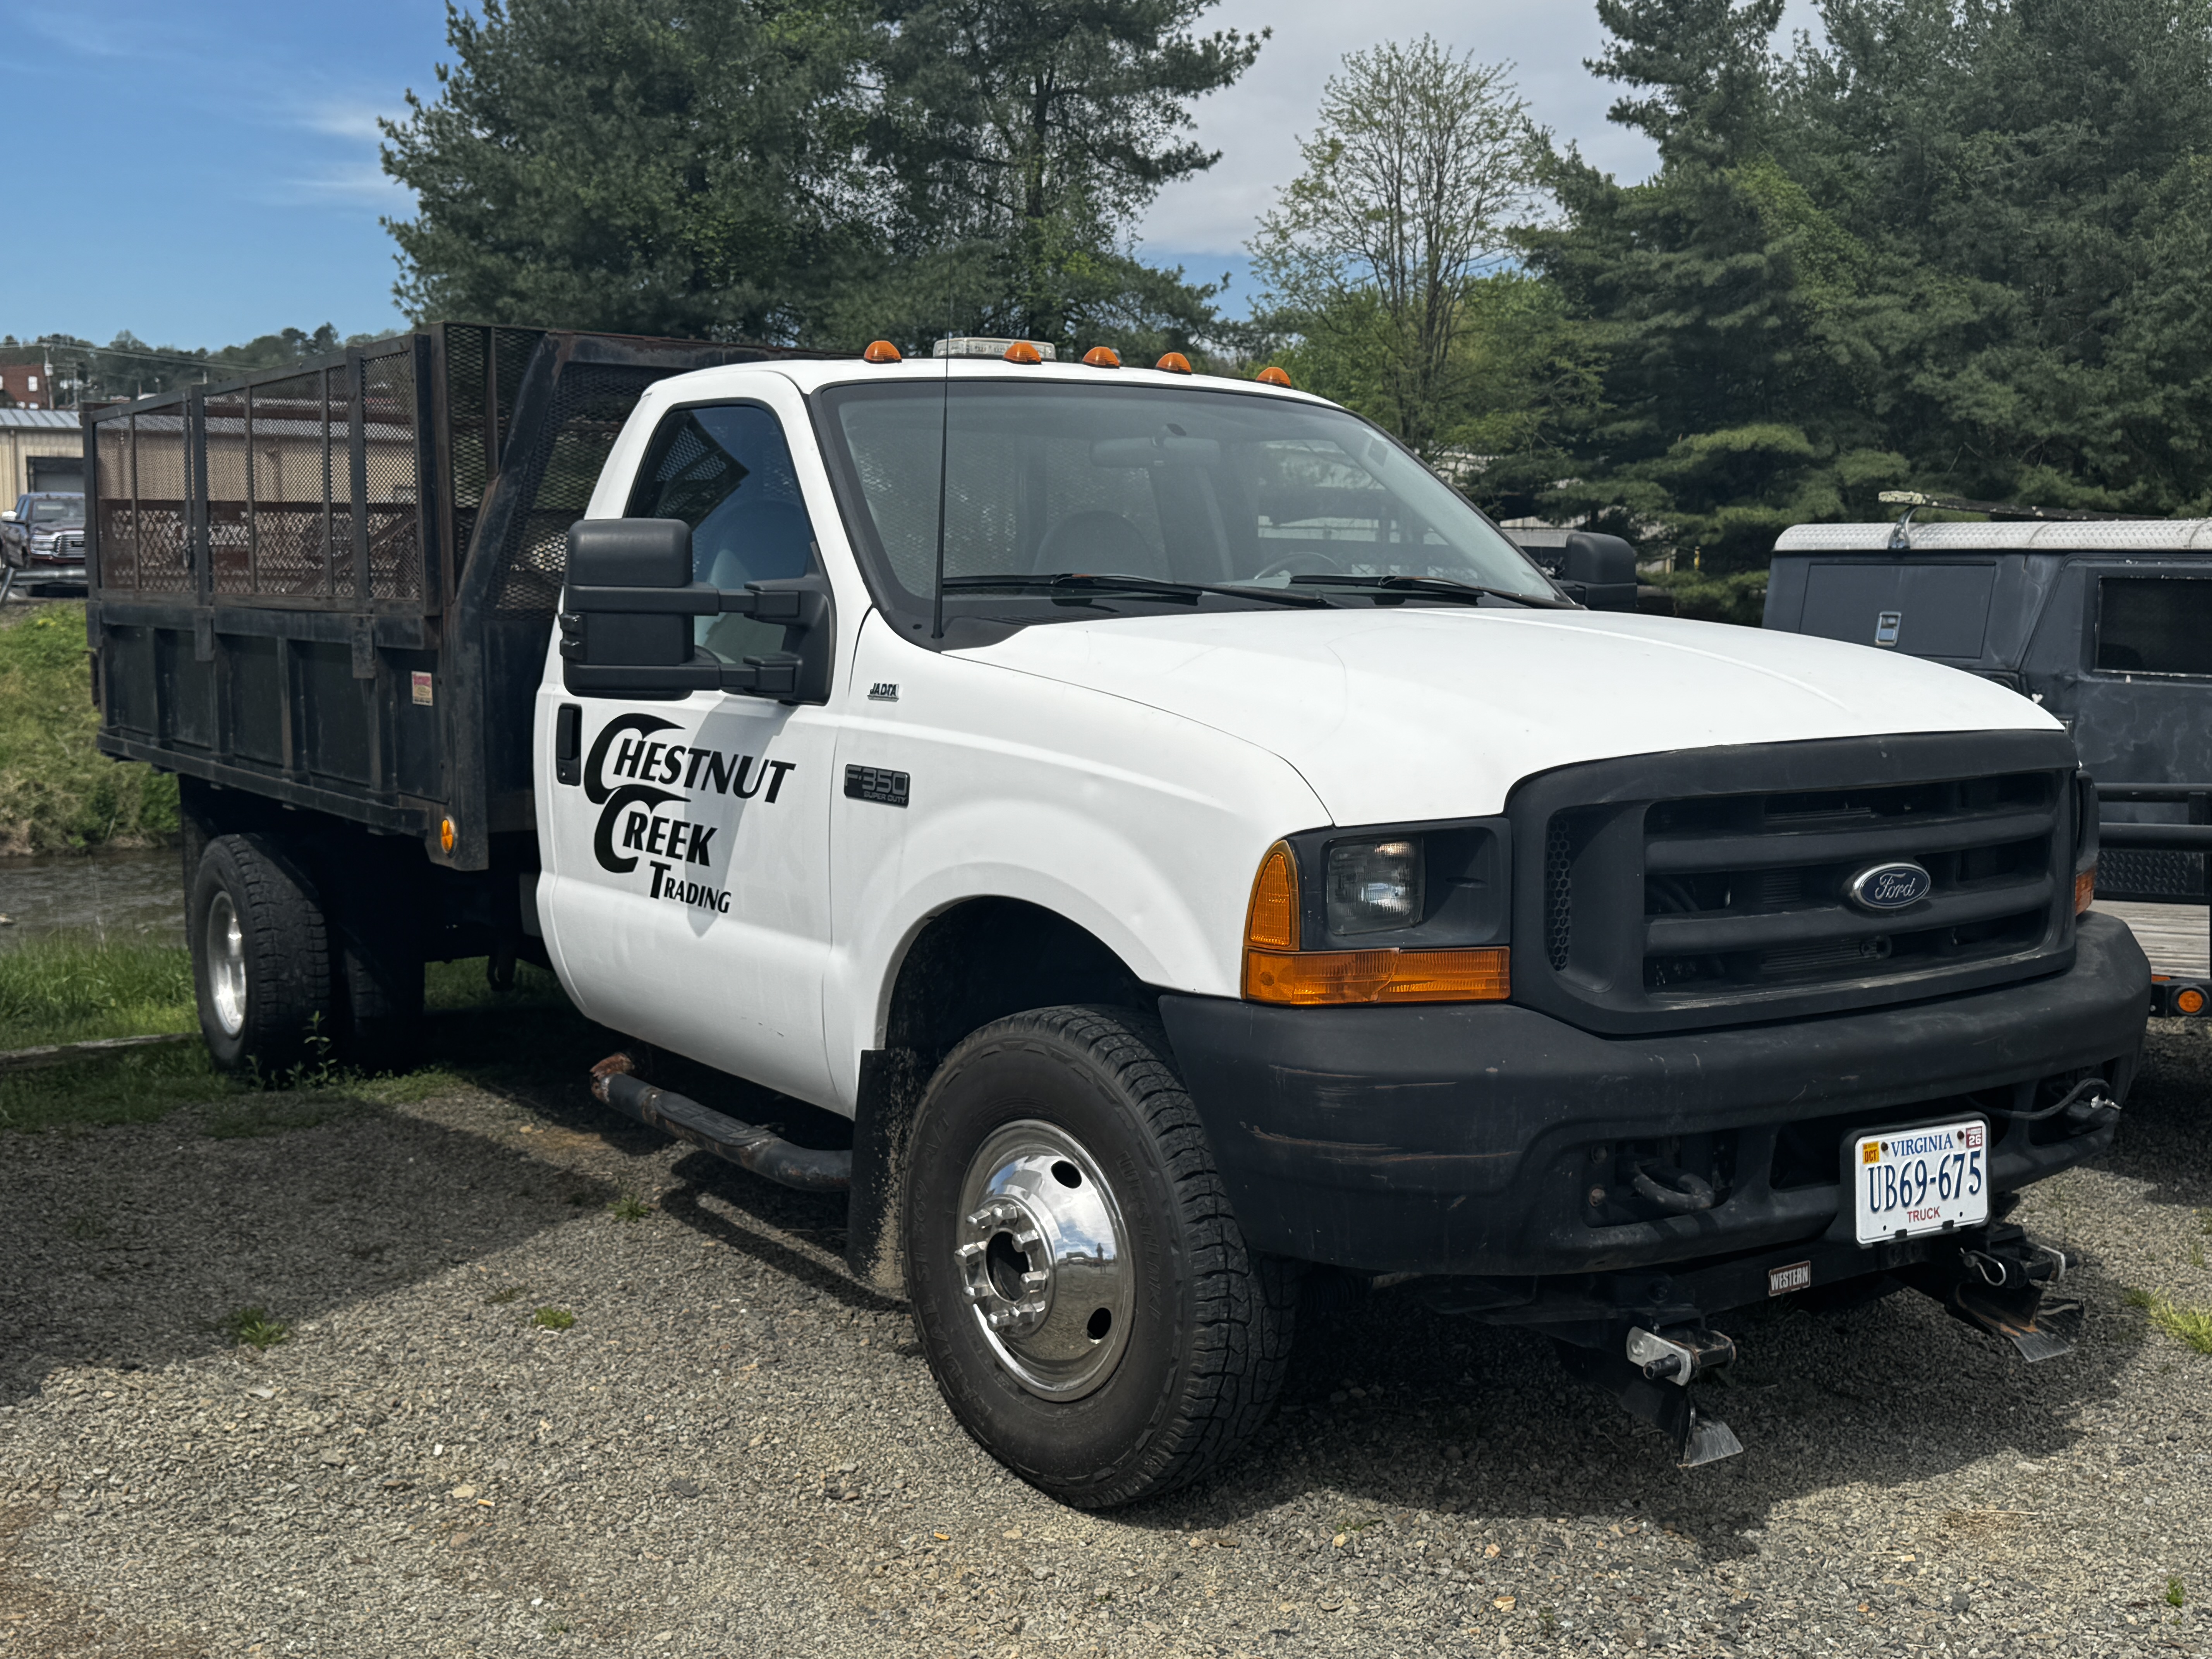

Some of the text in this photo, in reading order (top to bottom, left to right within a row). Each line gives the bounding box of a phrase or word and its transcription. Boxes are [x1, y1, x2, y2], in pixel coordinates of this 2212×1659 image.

[584, 713, 796, 805] CHESTNUT
[863, 791, 907, 804] SUPER DUTY
[594, 784, 718, 874] CREEK
[649, 860, 732, 914] TRADING
[1875, 872, 1916, 900] Ford
[1891, 1133, 1954, 1158] VIRGINIA
[1968, 1134, 1981, 1146] 26
[1865, 1149, 1877, 1163] OCT
[1867, 1149, 1982, 1214] UB69-675
[1906, 1206, 1941, 1223] TRUCK
[1770, 1265, 1808, 1291] WESTERN
